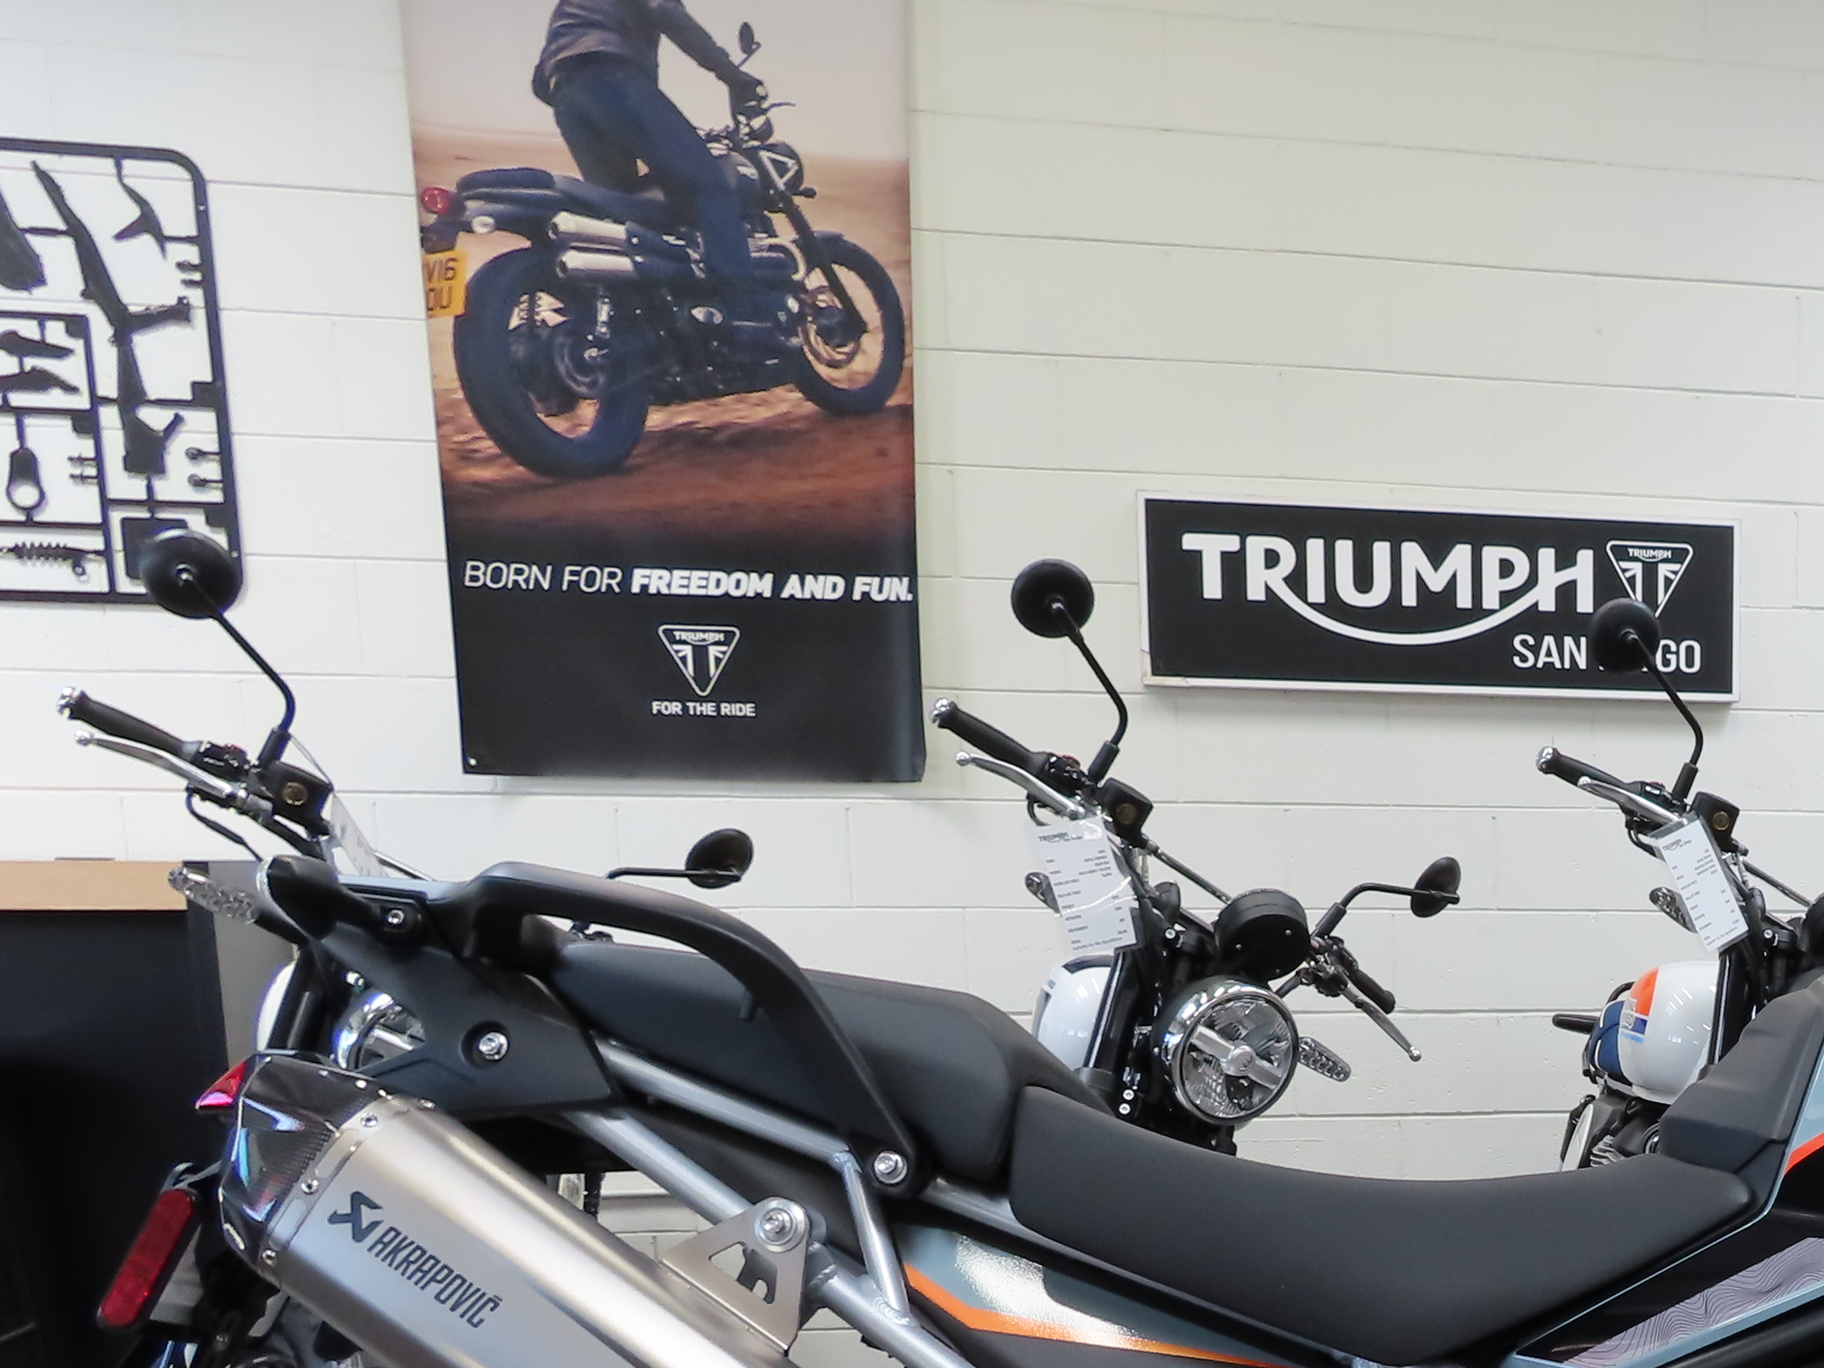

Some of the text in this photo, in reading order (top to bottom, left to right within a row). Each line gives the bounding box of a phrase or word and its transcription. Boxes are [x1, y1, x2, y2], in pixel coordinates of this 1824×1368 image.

[1628, 547, 1672, 562] TRIUMPH
[463, 560, 913, 601] BORN FOR FREEDOM AND FUN.
[1181, 532, 1595, 645] TRIUMPH
[673, 631, 725, 645] TRIUMPH
[1512, 633, 1588, 670] SAN
[651, 701, 756, 717] FOR THE RIDE
